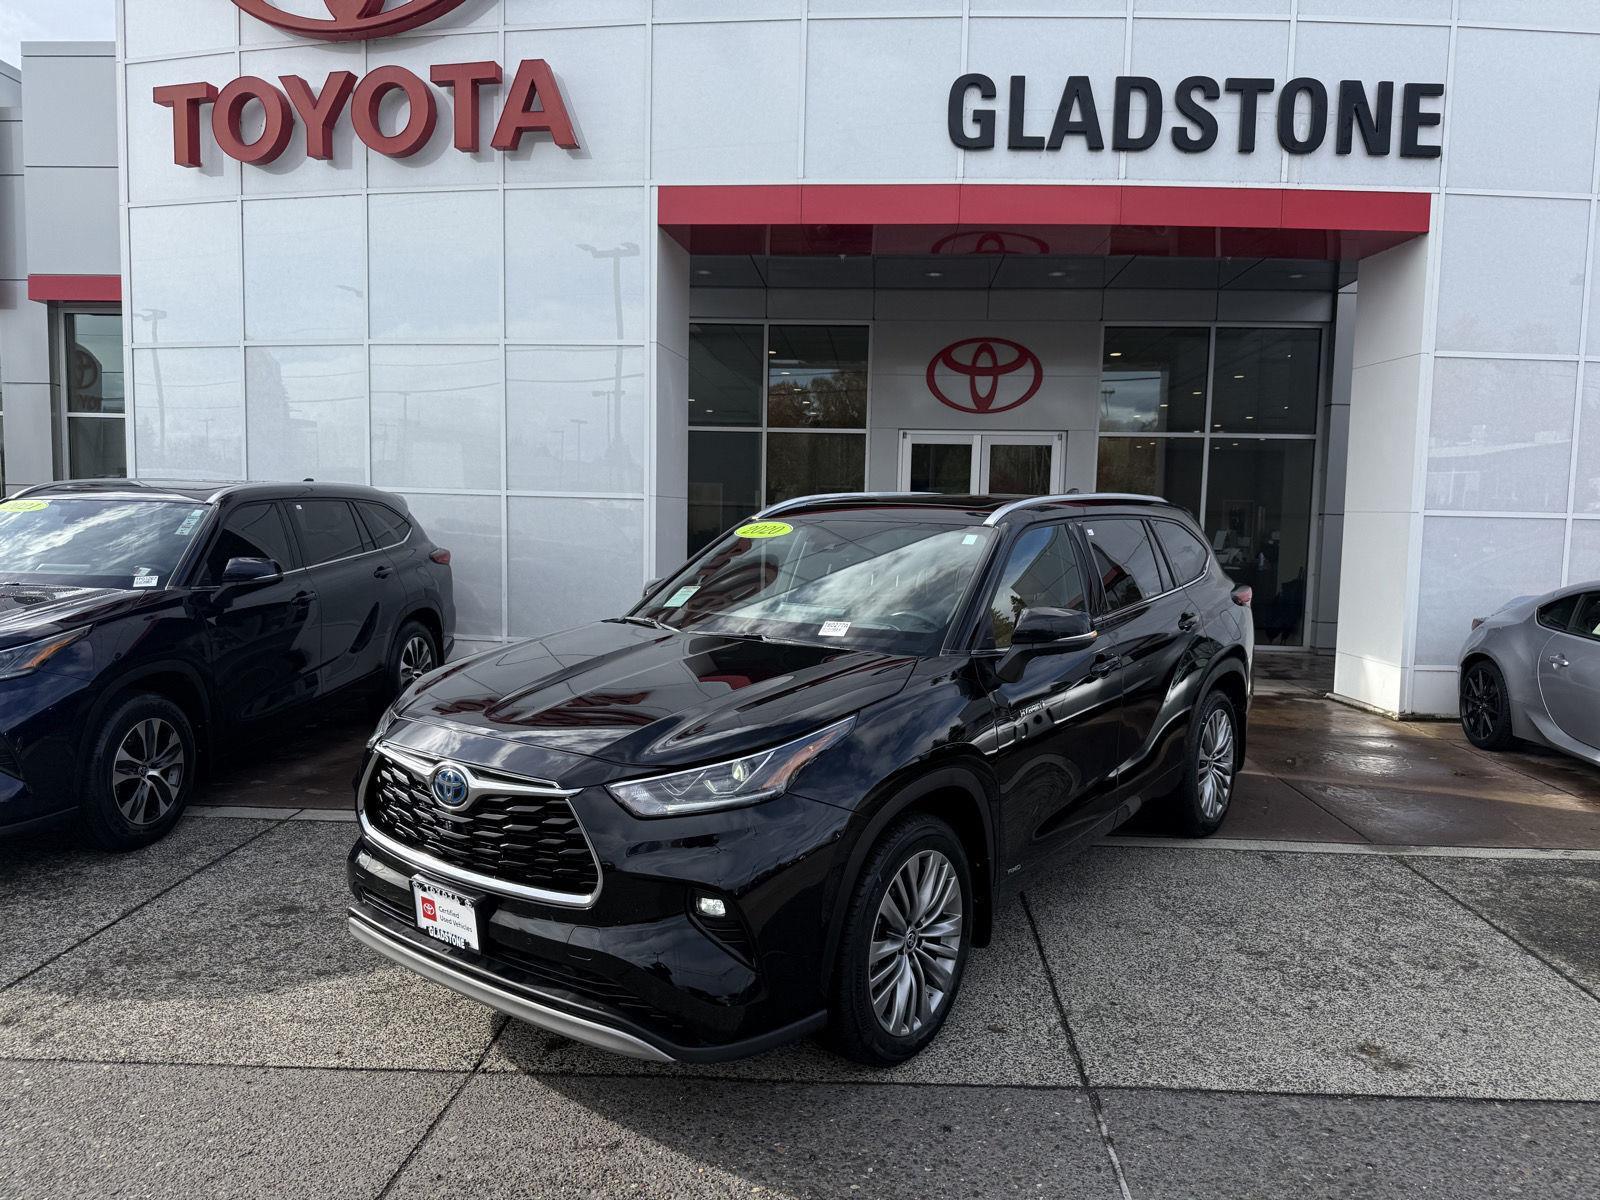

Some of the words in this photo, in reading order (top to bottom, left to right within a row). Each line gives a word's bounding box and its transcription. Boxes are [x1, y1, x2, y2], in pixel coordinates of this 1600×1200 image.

[153, 59, 580, 168] TOYOTA
[948, 73, 1445, 158] GLADSTONE
[740, 525, 787, 535] 2020
[438, 905, 460, 919] Certified
[439, 914, 452, 925] Used
[452, 920, 473, 933] Vehicles
[428, 926, 466, 950] GLADSTONE
